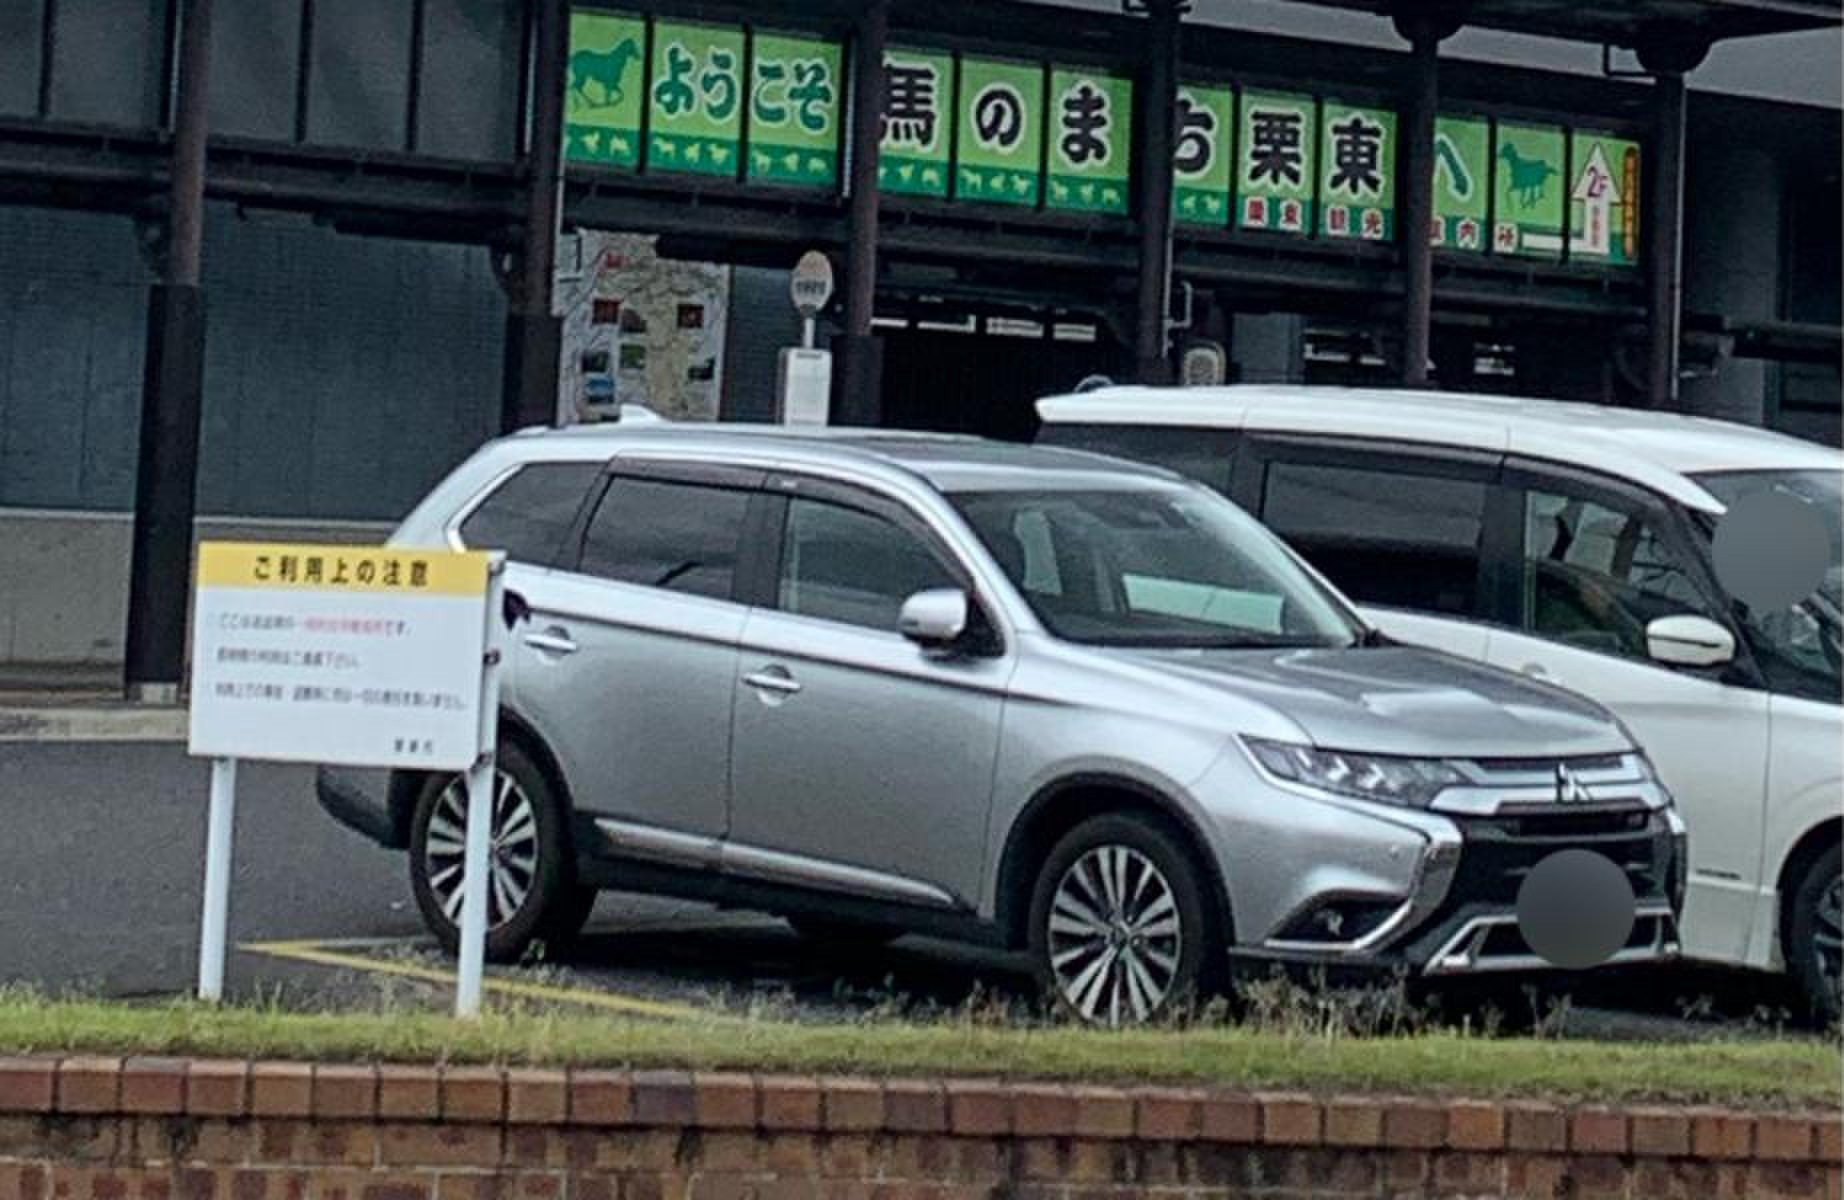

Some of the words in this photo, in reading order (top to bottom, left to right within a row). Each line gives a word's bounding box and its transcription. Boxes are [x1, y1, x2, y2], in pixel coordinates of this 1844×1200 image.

[652, 45, 834, 134] ようこそ
[254, 554, 430, 587] ご利用上の注意
